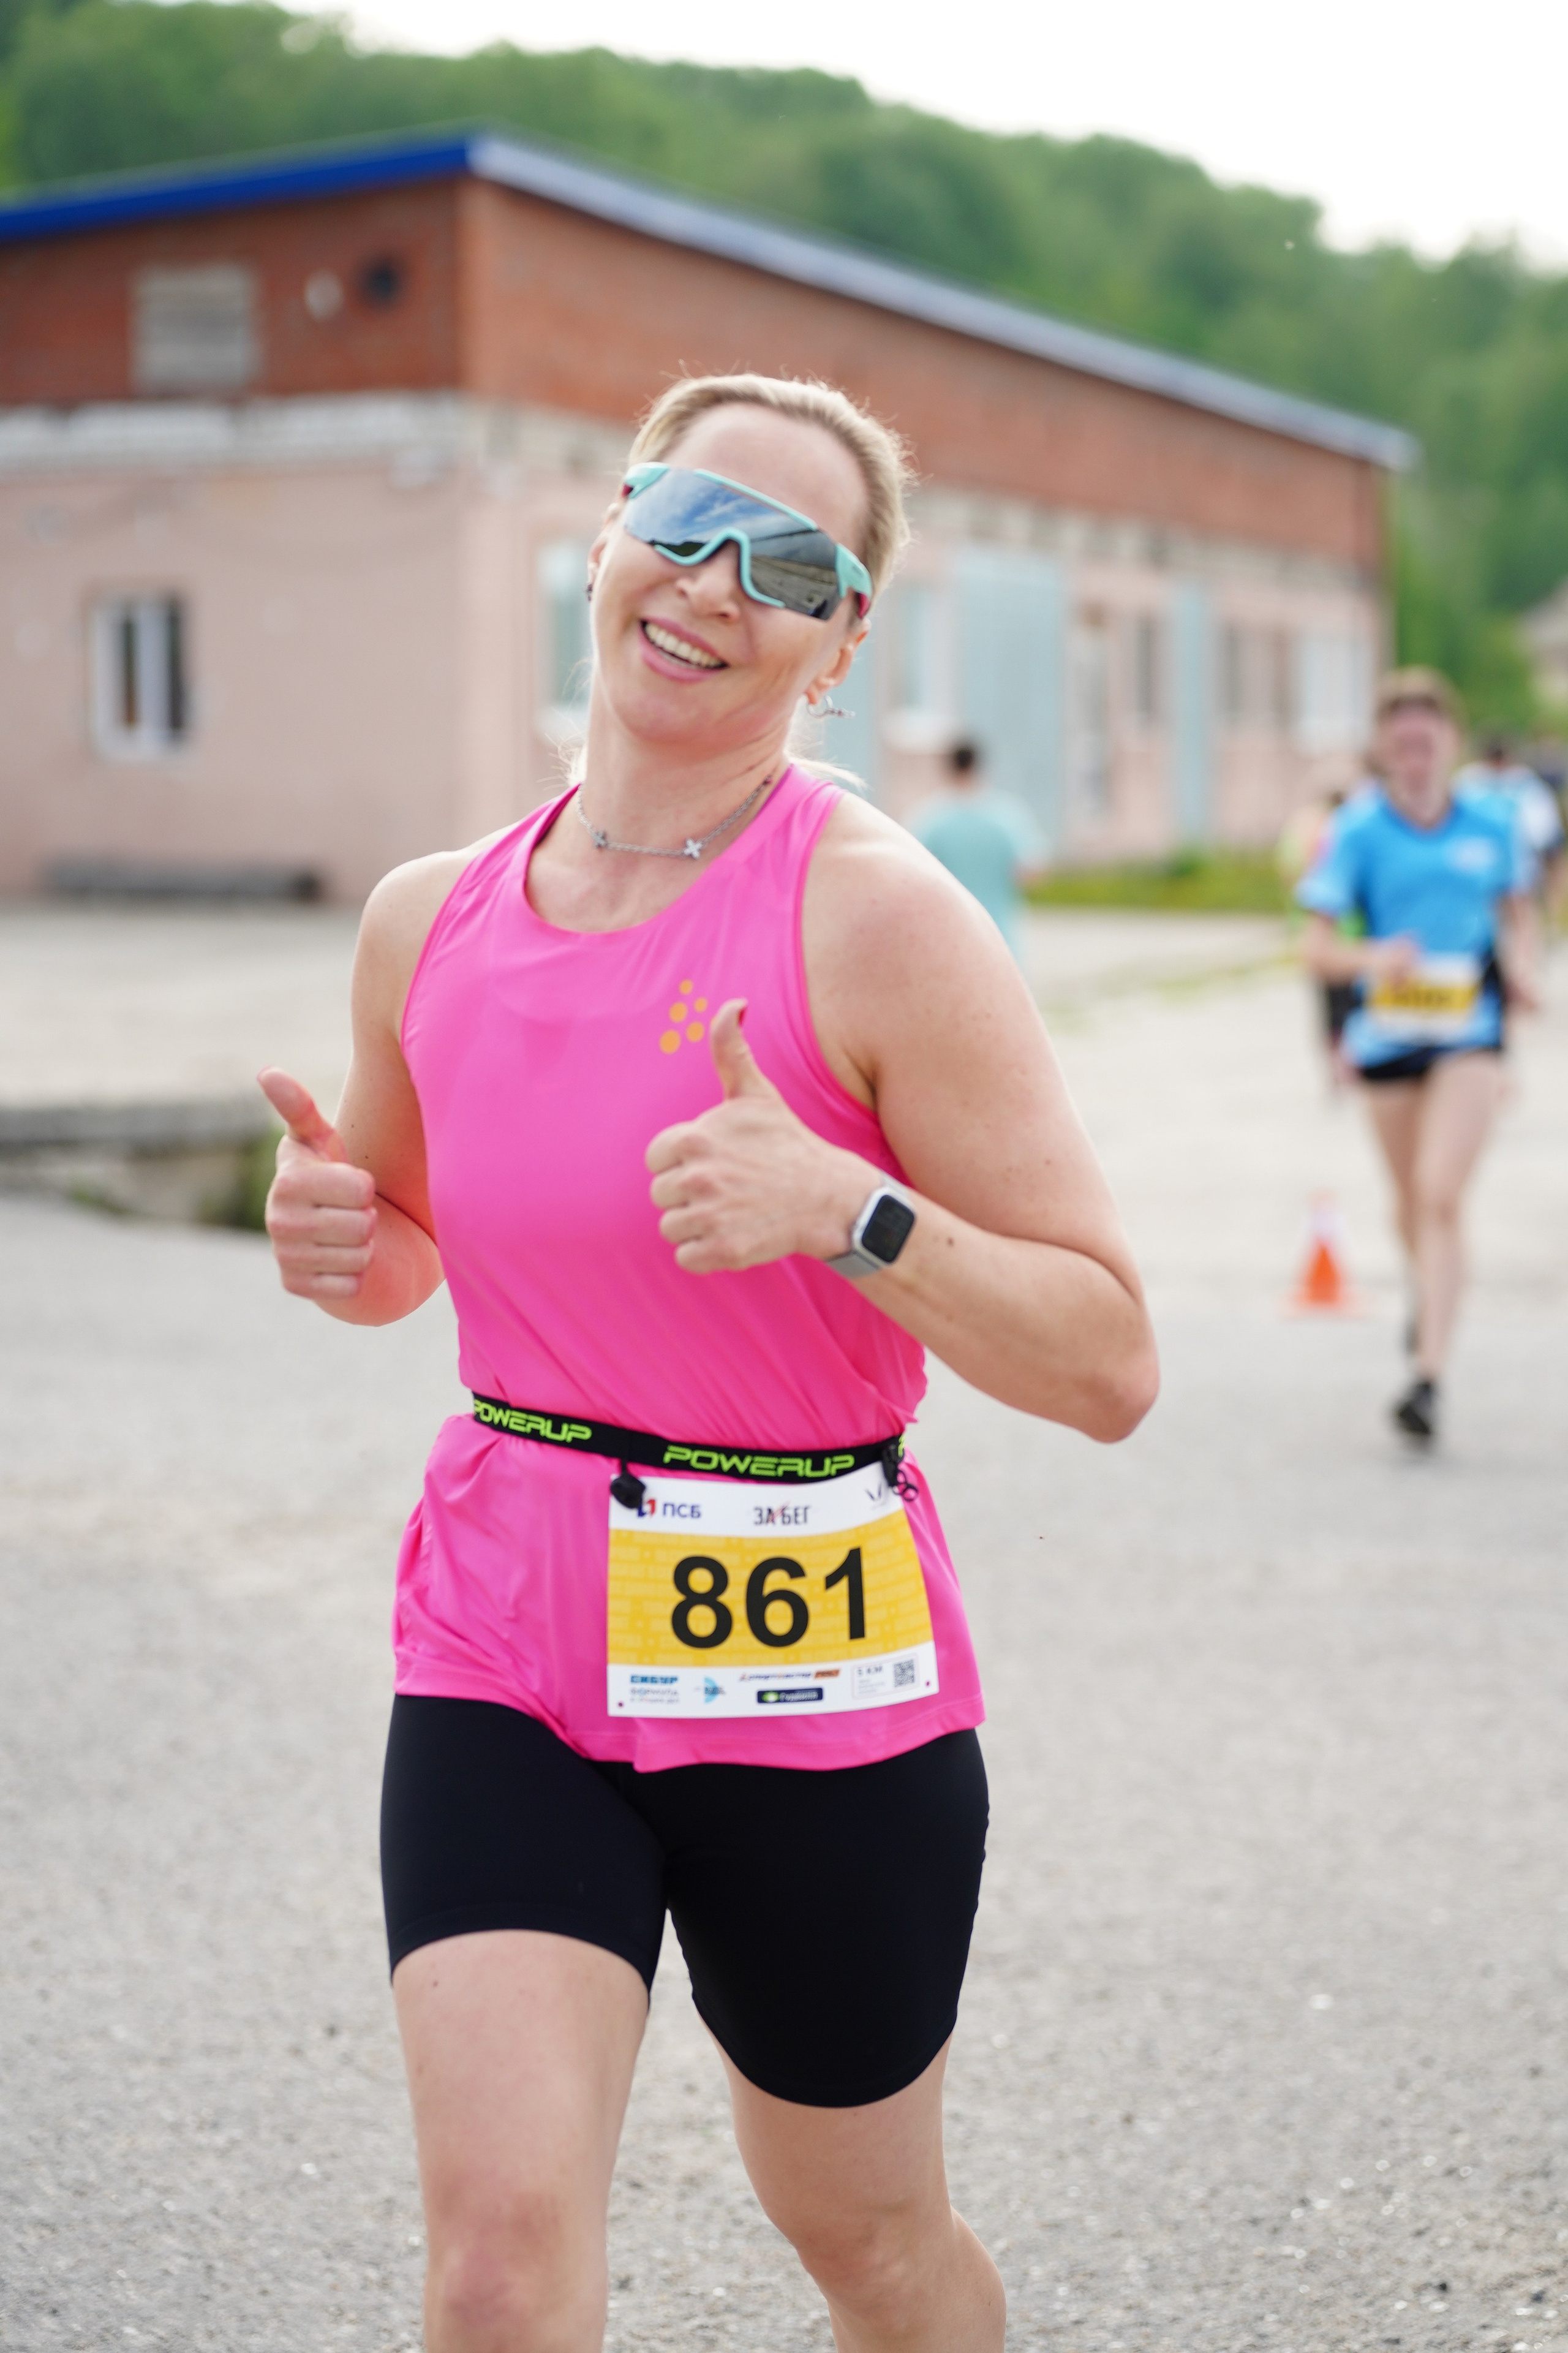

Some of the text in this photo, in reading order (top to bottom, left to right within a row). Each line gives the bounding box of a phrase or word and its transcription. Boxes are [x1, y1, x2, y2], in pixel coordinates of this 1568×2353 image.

[663, 1445, 855, 1478] POWERUP
[663, 1503, 701, 1519] ПСБ
[671, 1546, 865, 1649] 861
